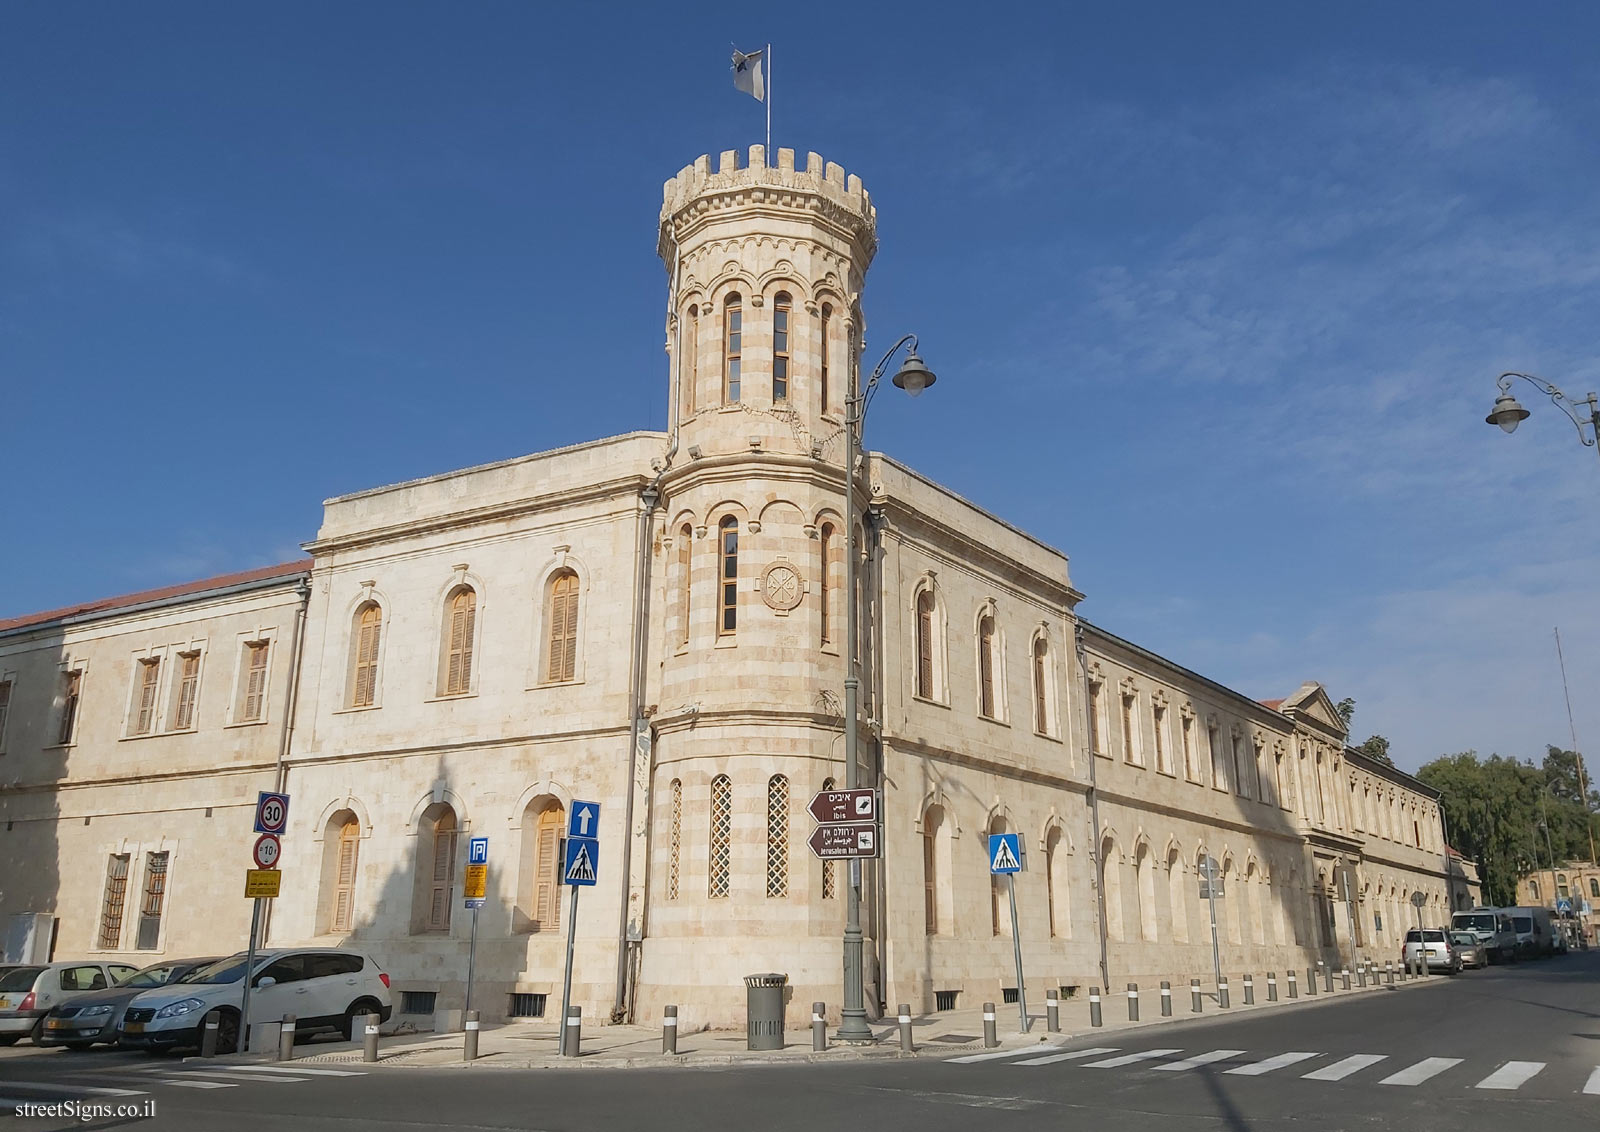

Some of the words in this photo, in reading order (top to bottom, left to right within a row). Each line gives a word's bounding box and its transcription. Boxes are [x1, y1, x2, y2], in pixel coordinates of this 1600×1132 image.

[829, 794, 850, 802] איביס
[265, 806, 280, 822] 30
[264, 845, 273, 855] 10
[821, 847, 847, 855] Jerusalem
